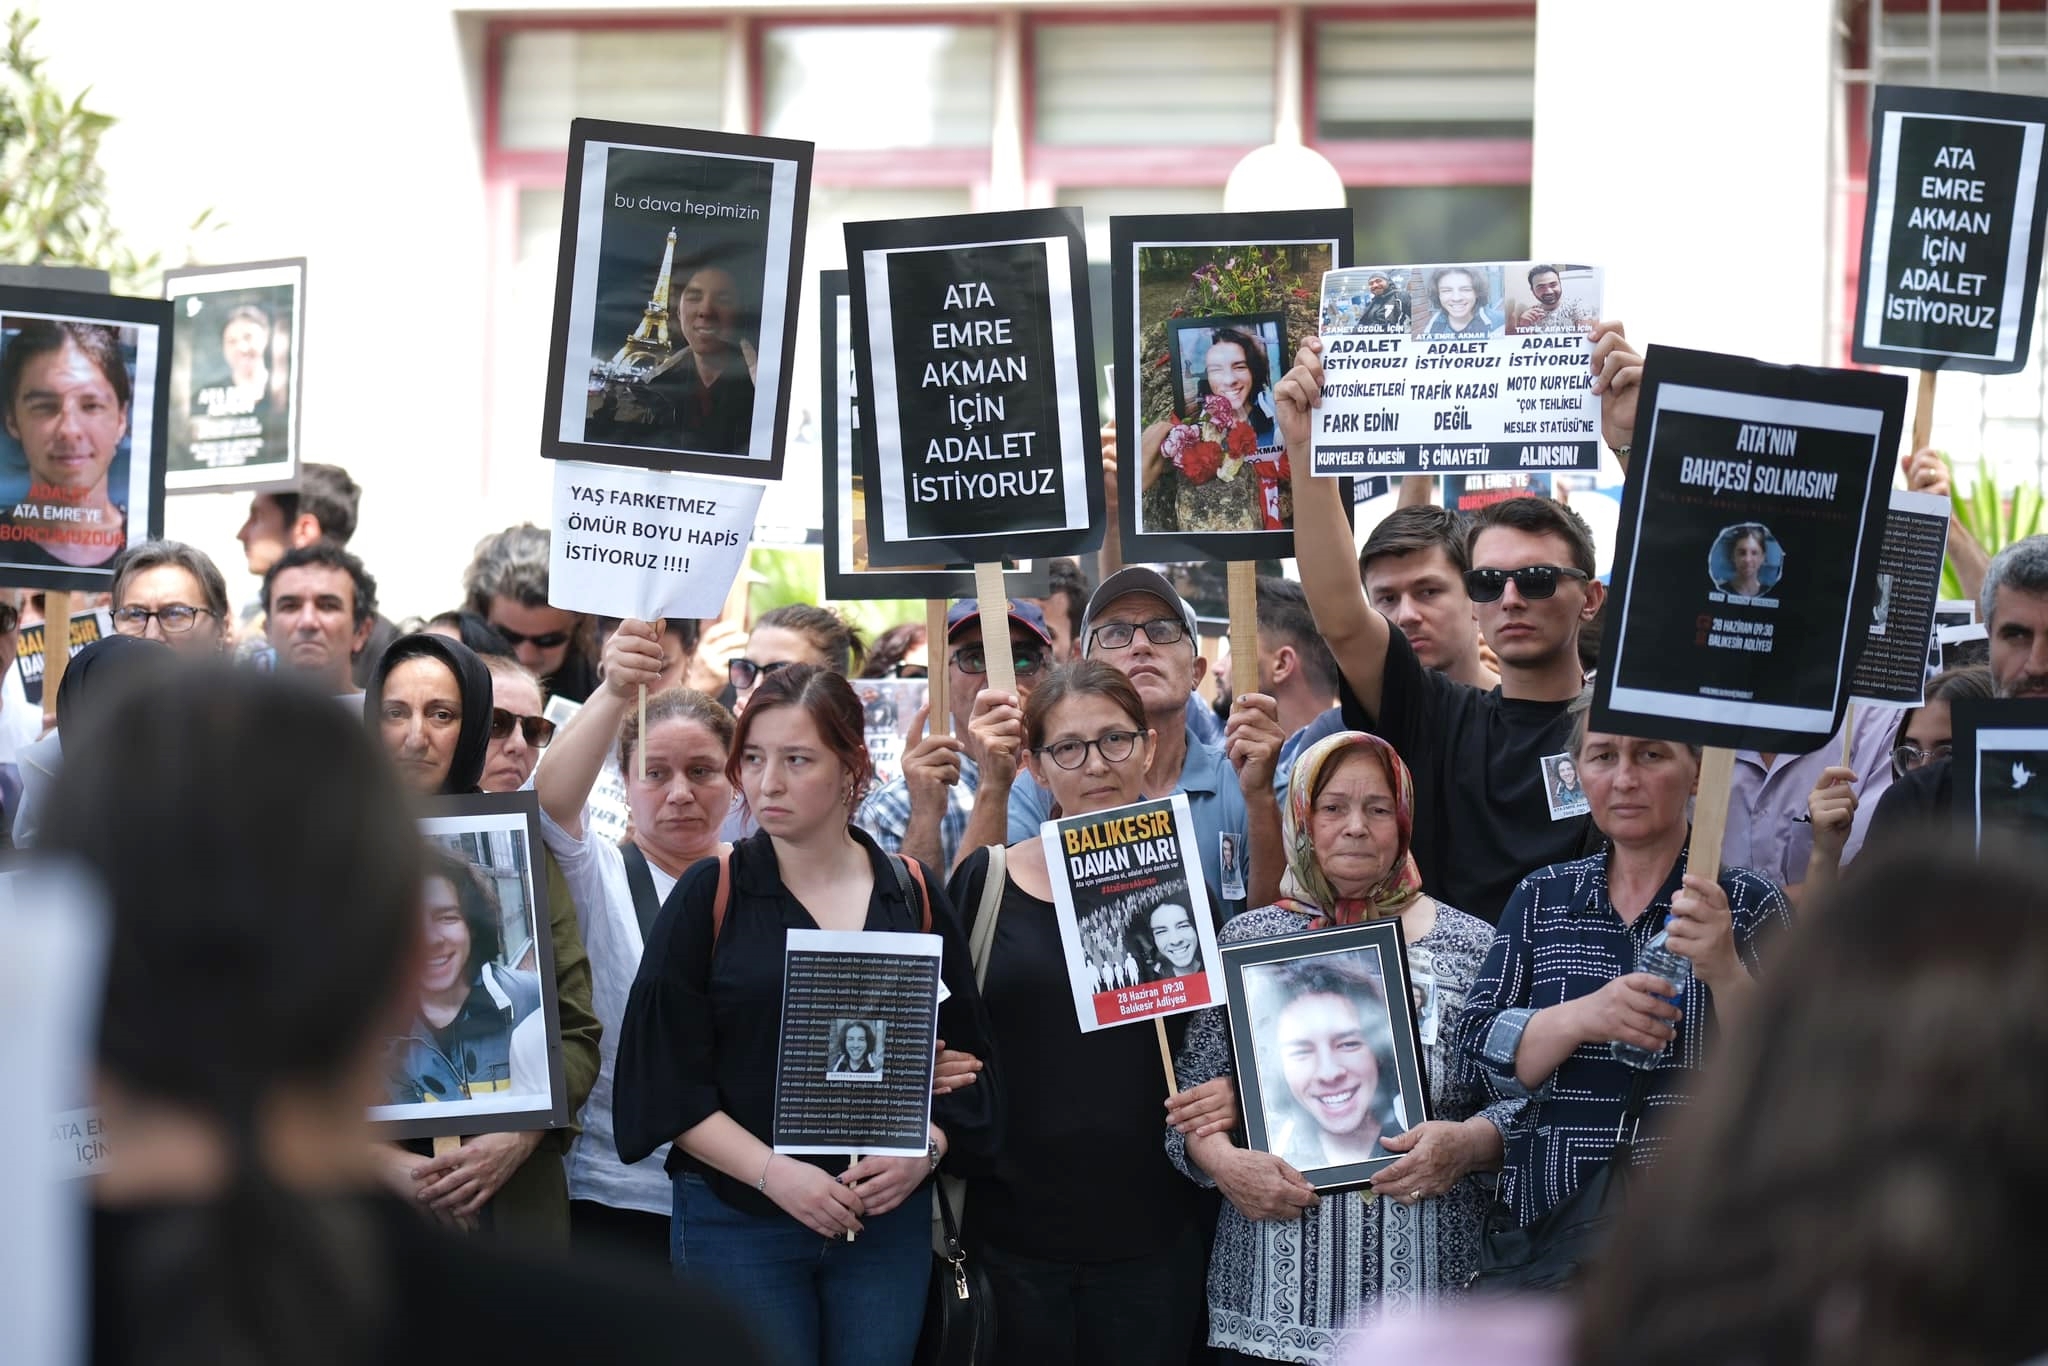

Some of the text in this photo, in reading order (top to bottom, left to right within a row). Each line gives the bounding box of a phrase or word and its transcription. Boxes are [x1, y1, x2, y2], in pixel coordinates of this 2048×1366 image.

[1934, 146, 1976, 171] ATA
[1921, 176, 1986, 203] EMRE
[615, 193, 760, 221] bu dava hepimizin
[1908, 207, 1991, 235] AKMAN
[1921, 234, 1967, 267] İÇİN
[1899, 268, 1987, 297] ADALET
[944, 282, 995, 311] ATA
[1886, 293, 1996, 329] İSTİYORUZ
[932, 318, 1013, 349] EMRE
[1330, 339, 1402, 353] ADALET
[1522, 337, 1583, 349] ADALET
[1427, 342, 1488, 354] ADALET
[921, 356, 1027, 388] AKMAN
[1507, 371, 1593, 391] MOTO KURYELİK
[1320, 378, 1406, 398] MOTOSİKLETLERİ
[1411, 379, 1499, 400] TRAFİK KAZASI
[949, 393, 1005, 430] İÇİN
[1540, 394, 1582, 410] TEHLİKELİ
[1323, 414, 1359, 433] FARK
[1434, 405, 1472, 430] DEĞİL
[1504, 422, 1537, 433] MESLEK
[925, 432, 1036, 464] ADALET
[1737, 425, 1797, 457] ATA'NIN
[1317, 447, 1405, 466] KURYELER ÖLMESİN
[1419, 444, 1429, 470] İŞ
[912, 468, 1056, 502] İSTİYORUZ
[1680, 456, 1838, 501] BAHÇESİ SOLMASIN!
[13, 504, 39, 519] ATA
[571, 485, 717, 516] YAŞ FARKETMEZ
[568, 512, 740, 546] ÖMÜR BOYU HAPİS
[566, 541, 690, 573] İSTİYORUZ !!!!
[1070, 836, 1178, 880] DAVAN VAR!
[1117, 981, 1185, 1004] 28 Haziran 09:30
[1120, 993, 1187, 1015] Balıkesir Adliyesi
